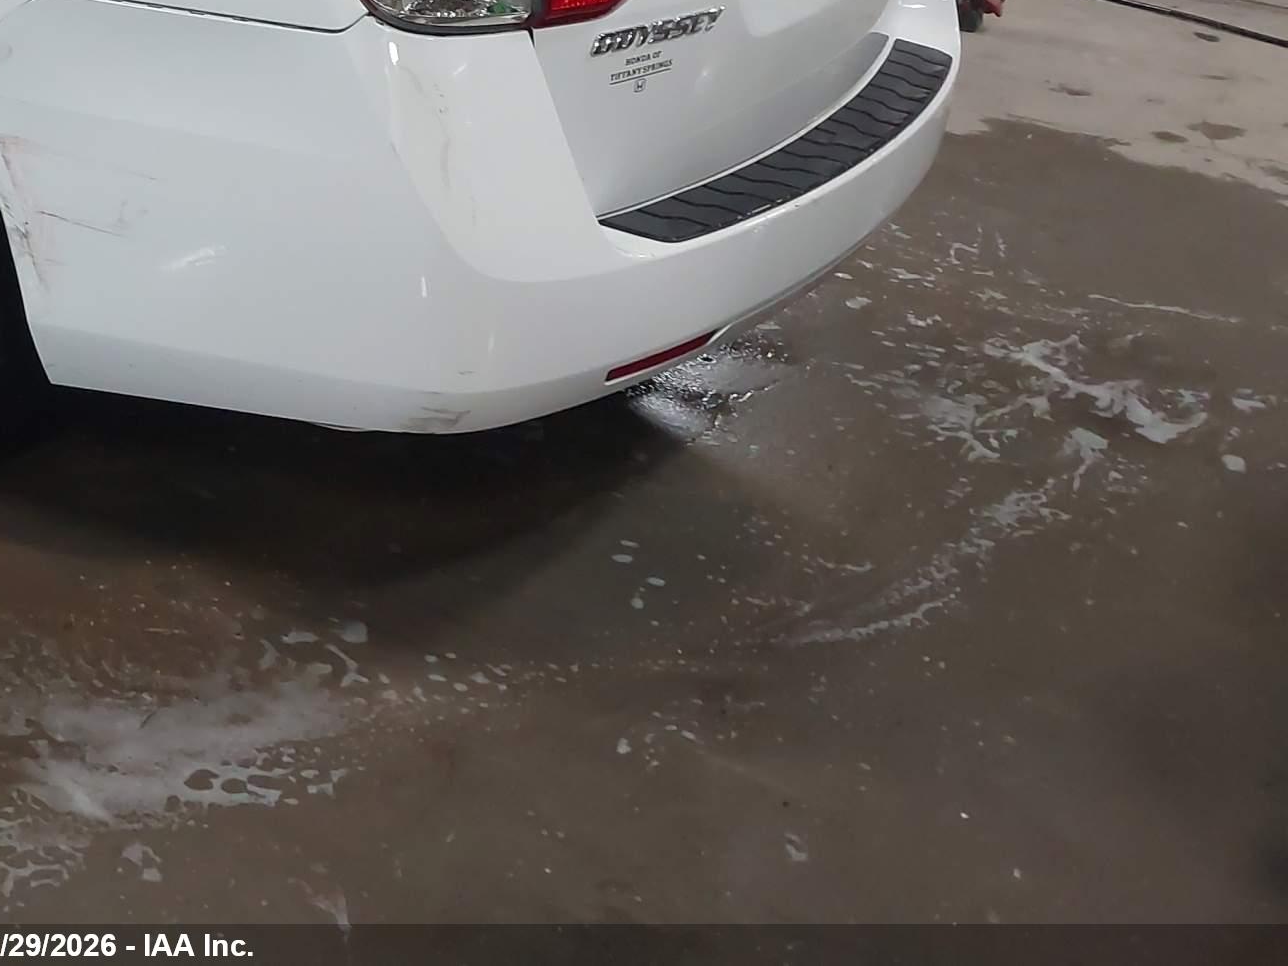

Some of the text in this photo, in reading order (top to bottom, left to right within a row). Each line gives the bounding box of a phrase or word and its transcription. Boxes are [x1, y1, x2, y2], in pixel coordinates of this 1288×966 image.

[590, 5, 726, 57] ODYSSEY
[625, 50, 662, 66] HONDA OF
